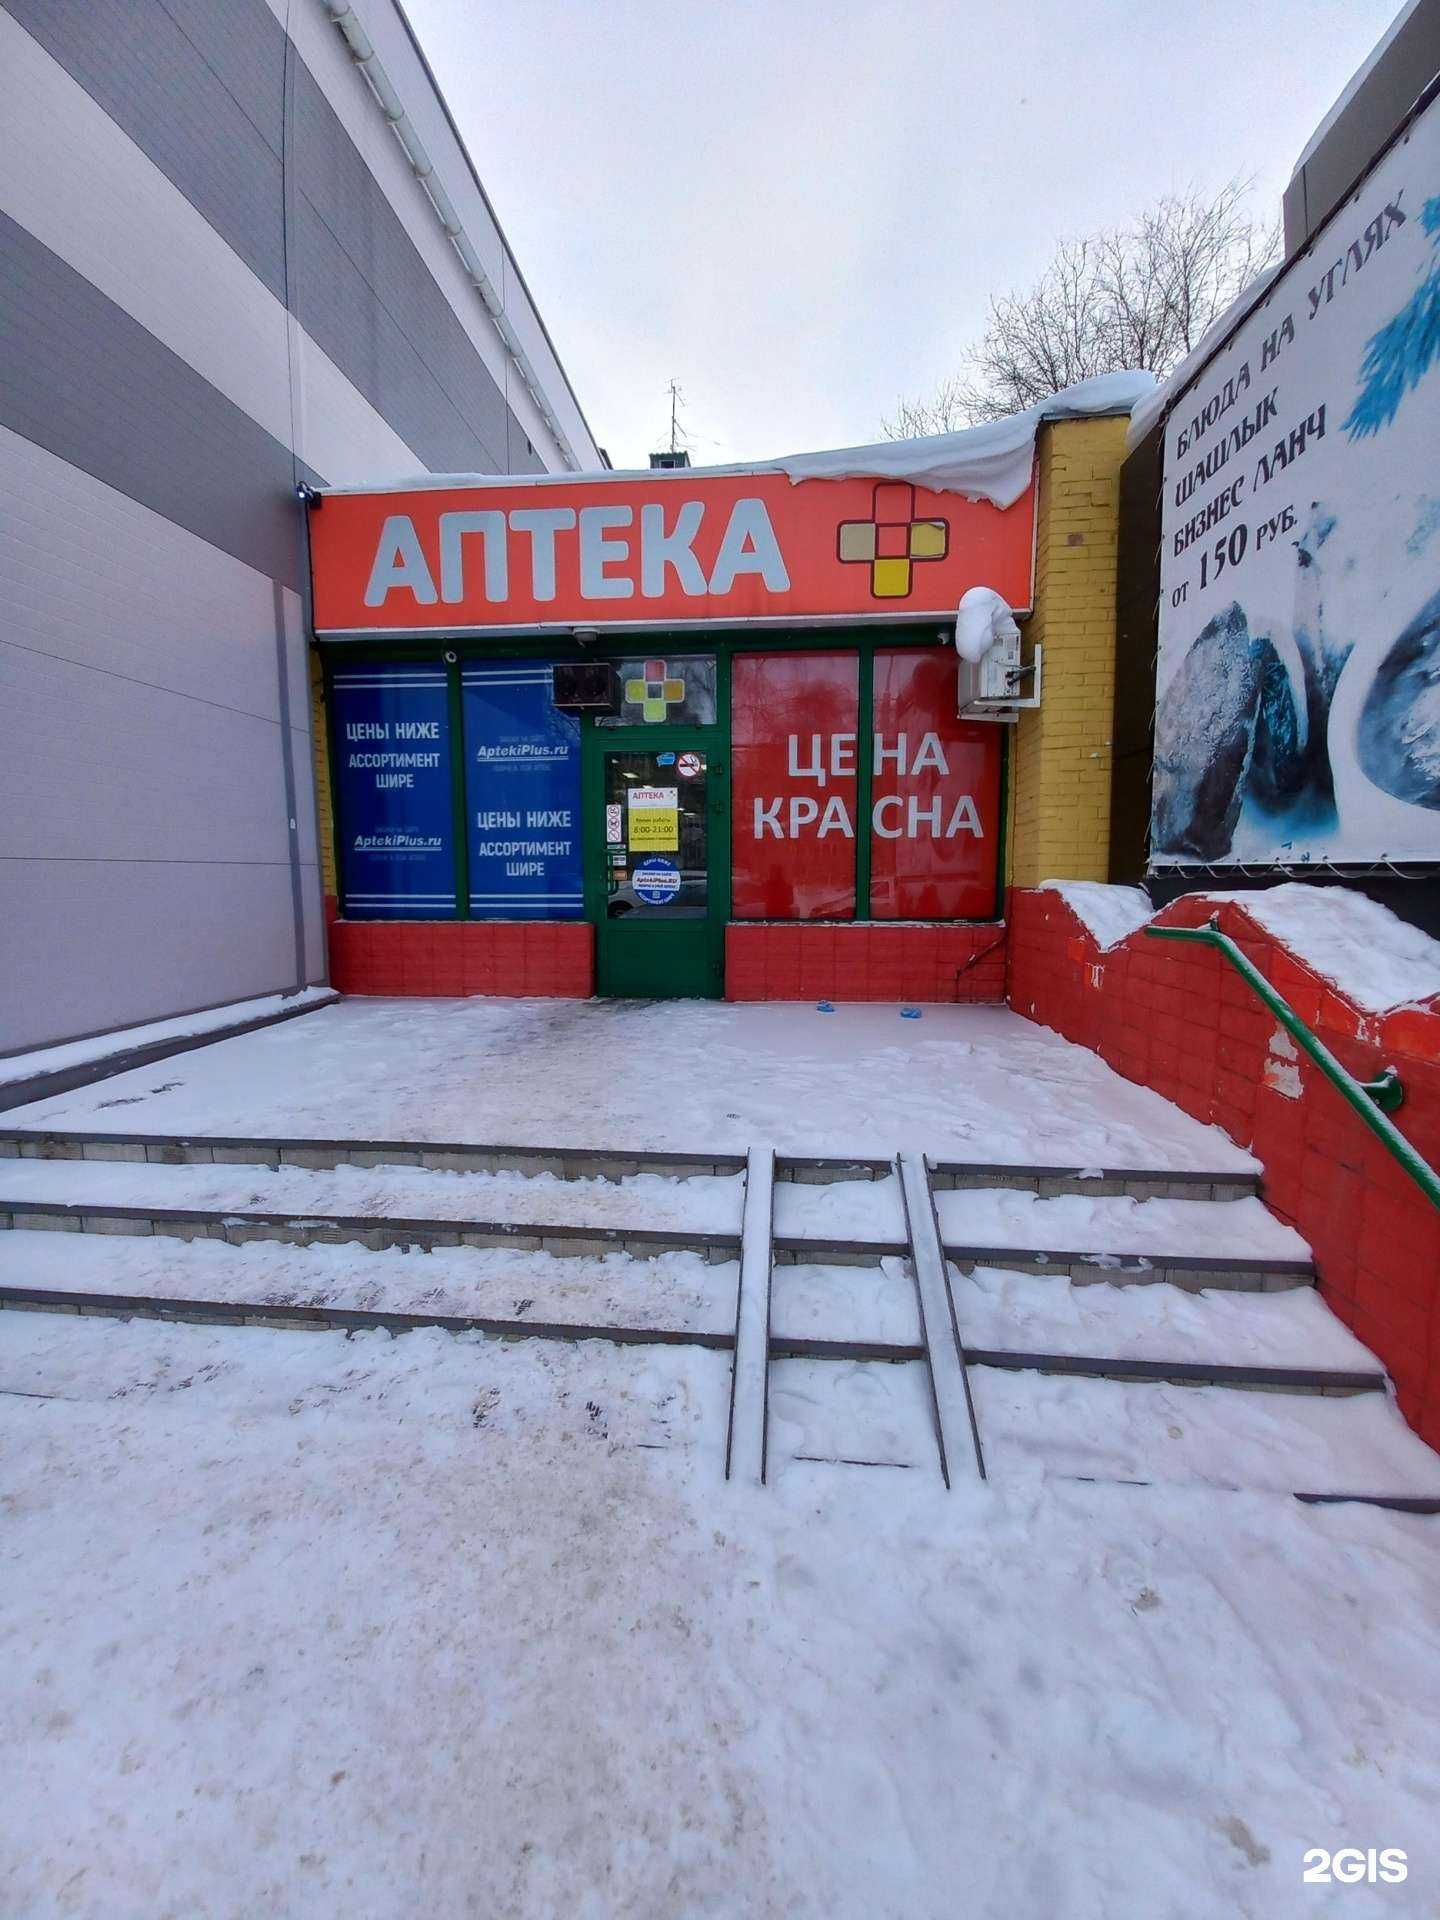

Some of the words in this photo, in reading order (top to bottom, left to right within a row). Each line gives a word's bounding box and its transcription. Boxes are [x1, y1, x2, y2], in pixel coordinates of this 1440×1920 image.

[1175, 361, 1251, 461] БЛЮДА
[1260, 313, 1296, 373] НА
[1307, 187, 1408, 321] УГЛЯХ
[1174, 386, 1280, 508] ШАШЛЫК
[1173, 475, 1245, 558] БИЗНЕС
[1252, 403, 1327, 494] ЛАНЧ
[363, 498, 792, 608] АПТЕКА
[1199, 519, 1249, 592] 150
[346, 722, 390, 742] ЦЕНЫ
[395, 721, 440, 740] НИЖЕ
[349, 753, 441, 769] АССОРТИМЕНТ
[477, 744, 569, 759] AptekiPlus.ru
[788, 732, 950, 787] ЦЕНА
[376, 773, 415, 789] ШИРЕ
[632, 791, 665, 800] АПТЕКА
[477, 811, 521, 831] ЦЕНЫ
[526, 810, 572, 828] НИЖЕ
[753, 795, 985, 840] КРАСНА
[354, 834, 442, 848] AptekiPlus.ru
[479, 841, 572, 857] АССОРТИМЕНТ
[506, 862, 545, 877] ШИРЕ
